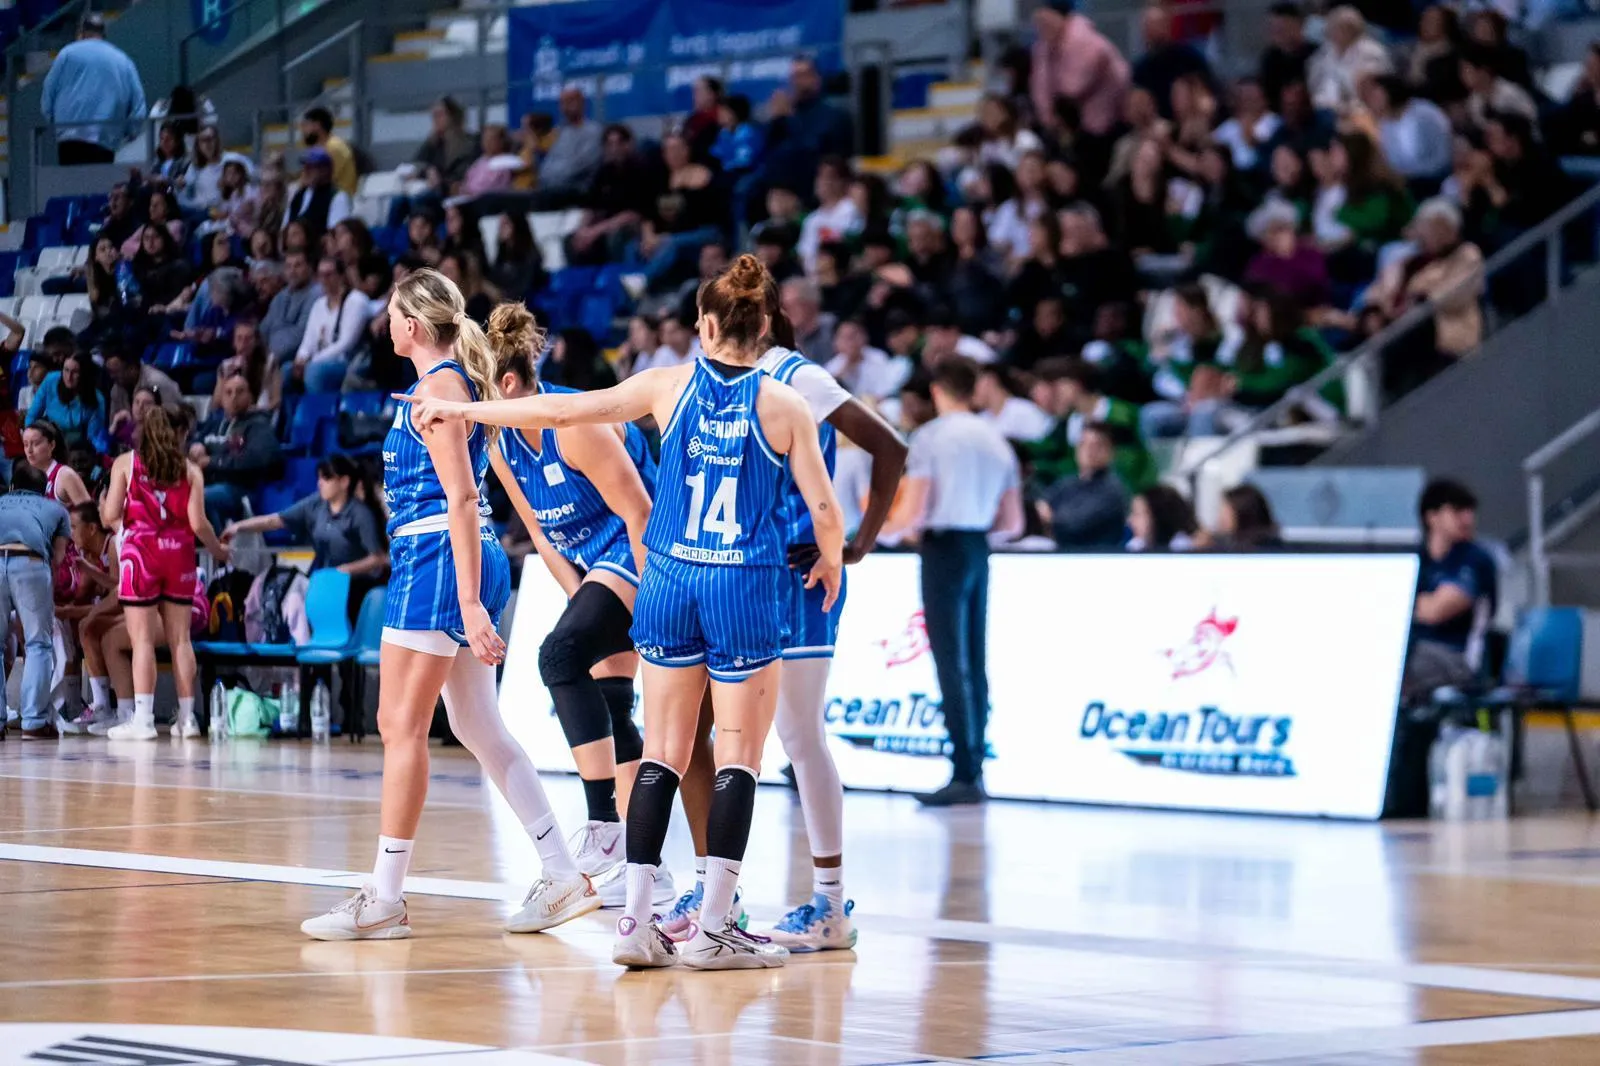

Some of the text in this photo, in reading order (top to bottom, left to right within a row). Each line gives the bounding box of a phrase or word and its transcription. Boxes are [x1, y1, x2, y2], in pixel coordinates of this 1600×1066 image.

[685, 470, 742, 545] 14
[824, 697, 901, 728] cean
[1080, 700, 1293, 747] Ocean Tours
